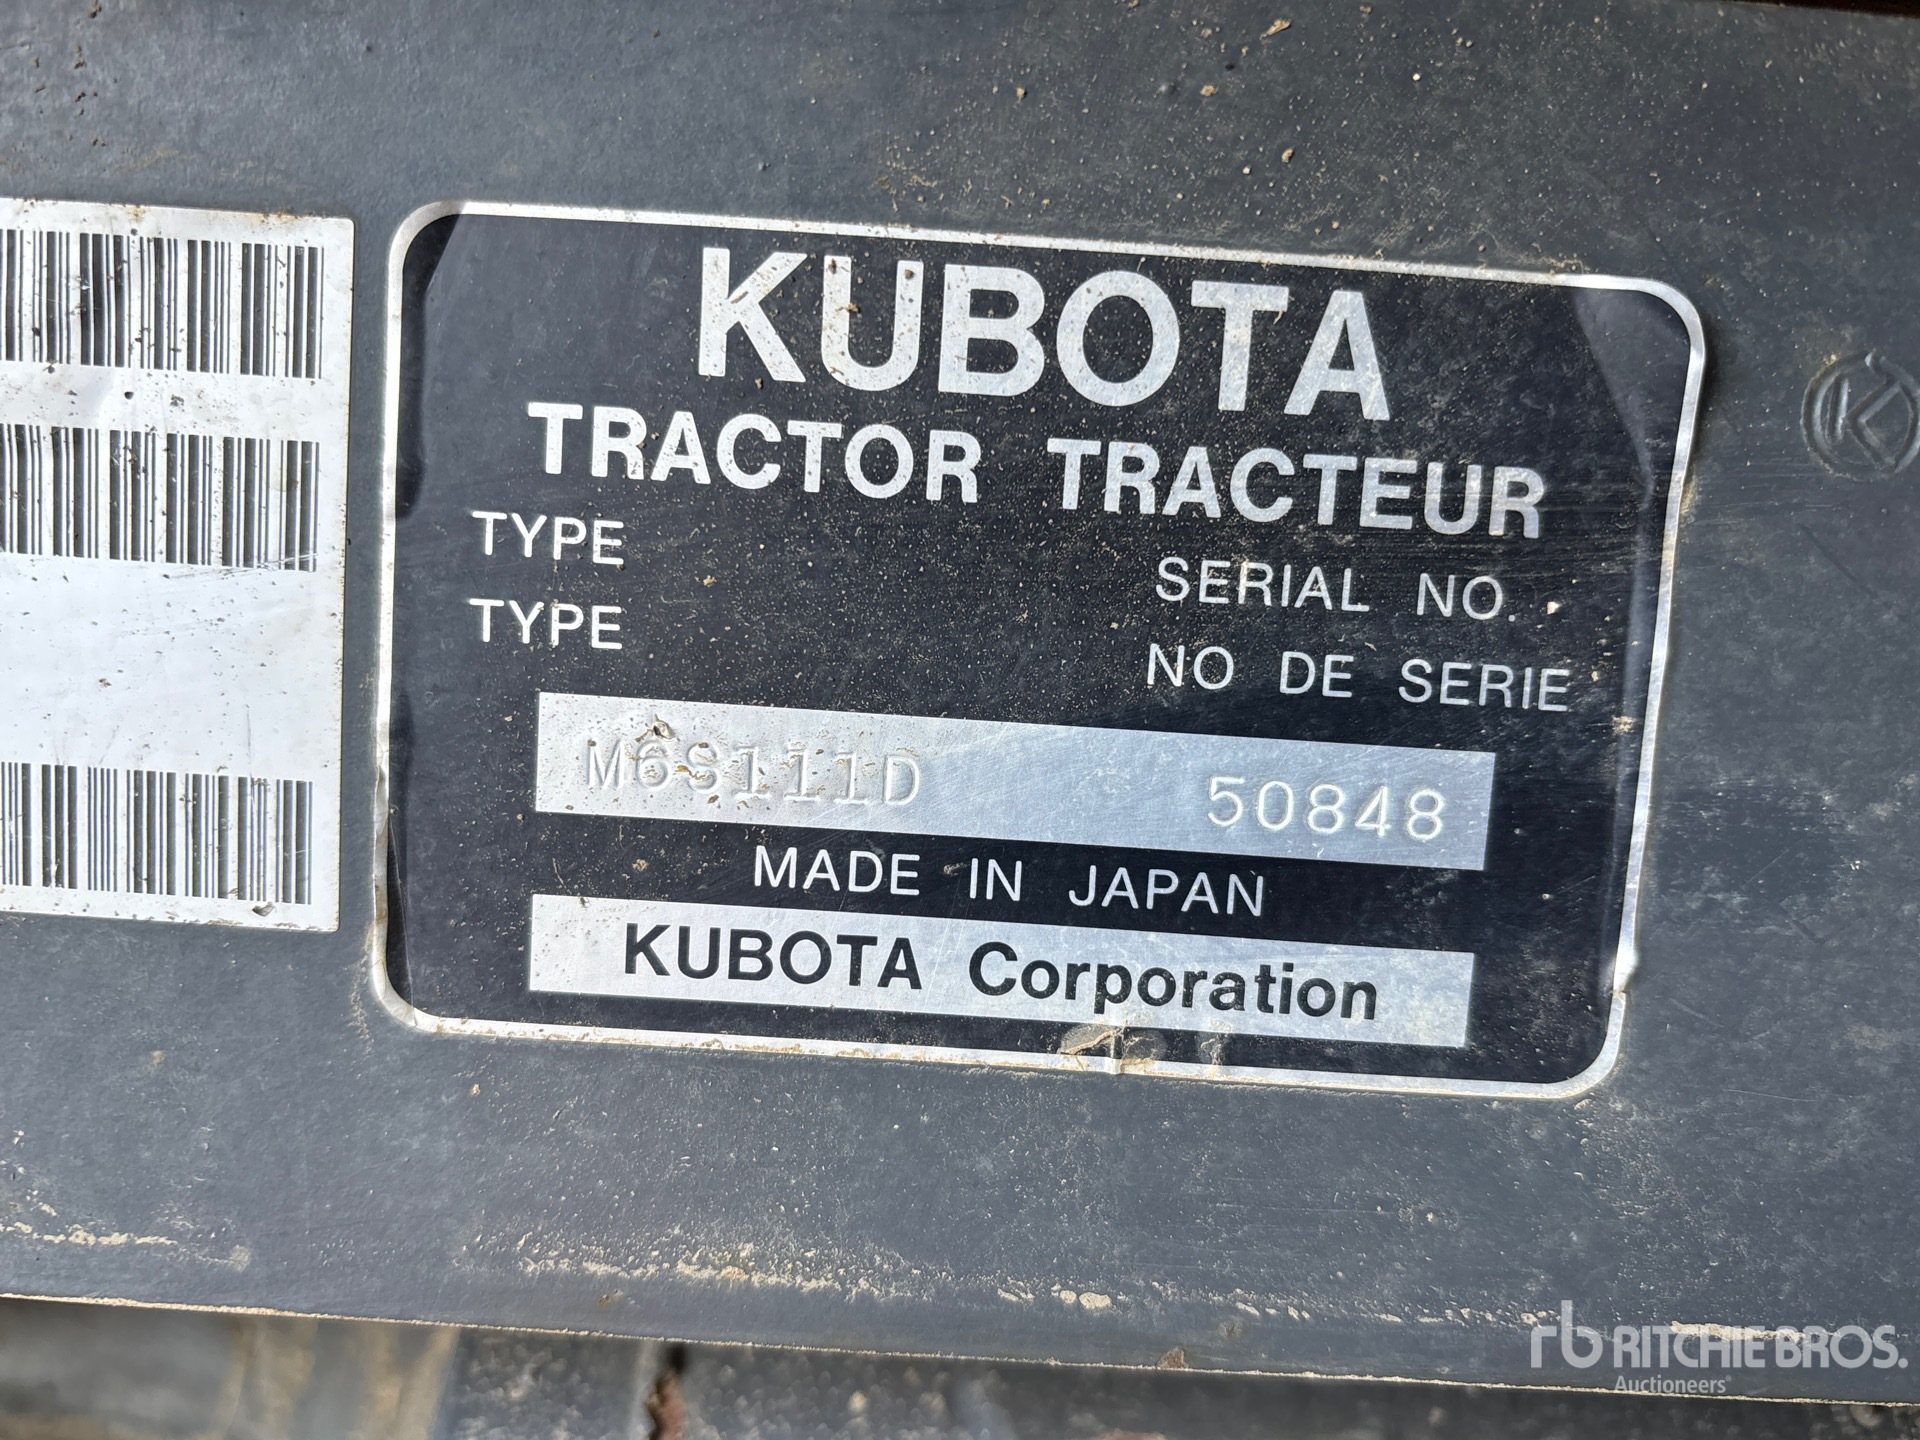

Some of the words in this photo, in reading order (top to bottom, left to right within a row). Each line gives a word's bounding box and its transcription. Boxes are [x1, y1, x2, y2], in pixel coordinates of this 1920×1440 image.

[698, 246, 1391, 421] KUBOTA
[527, 402, 983, 503] TRACTOR
[1046, 437, 1547, 539] TRACTEUR
[472, 510, 625, 566] TYPE
[468, 597, 623, 650] TYPE
[1155, 556, 1370, 613] SERIAL
[1416, 573, 1517, 622] NO.
[1145, 643, 1235, 691] NO
[1279, 651, 1354, 699] DE
[1399, 657, 1571, 713] SERIE
[585, 737, 922, 806] M6S111D
[1207, 776, 1446, 841] 50848
[753, 845, 921, 896] MADE
[968, 857, 1023, 902] IN
[1068, 864, 1264, 917] JAPAN
[623, 922, 923, 991] KUBOTA
[968, 941, 1378, 1021] Corporation
